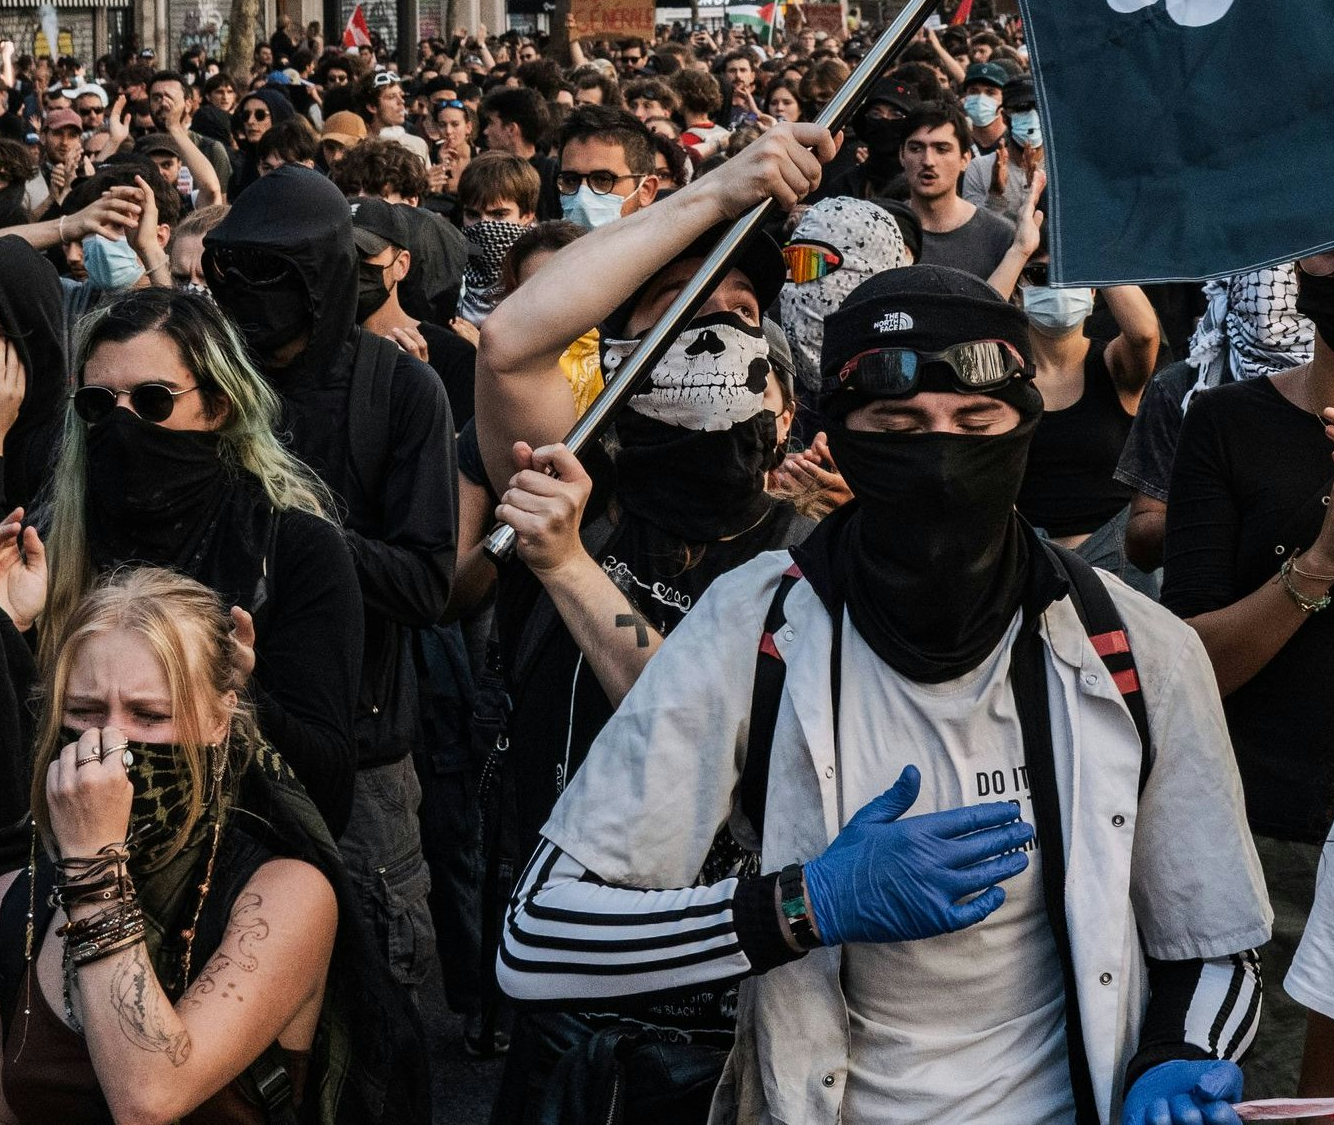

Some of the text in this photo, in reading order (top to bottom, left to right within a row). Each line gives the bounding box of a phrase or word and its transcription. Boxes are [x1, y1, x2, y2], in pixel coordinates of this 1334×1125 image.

[884, 312, 899, 321] THE
[873, 318, 898, 329] NORTH
[879, 324, 898, 333] FACE
[976, 765, 1029, 797] DO IT
